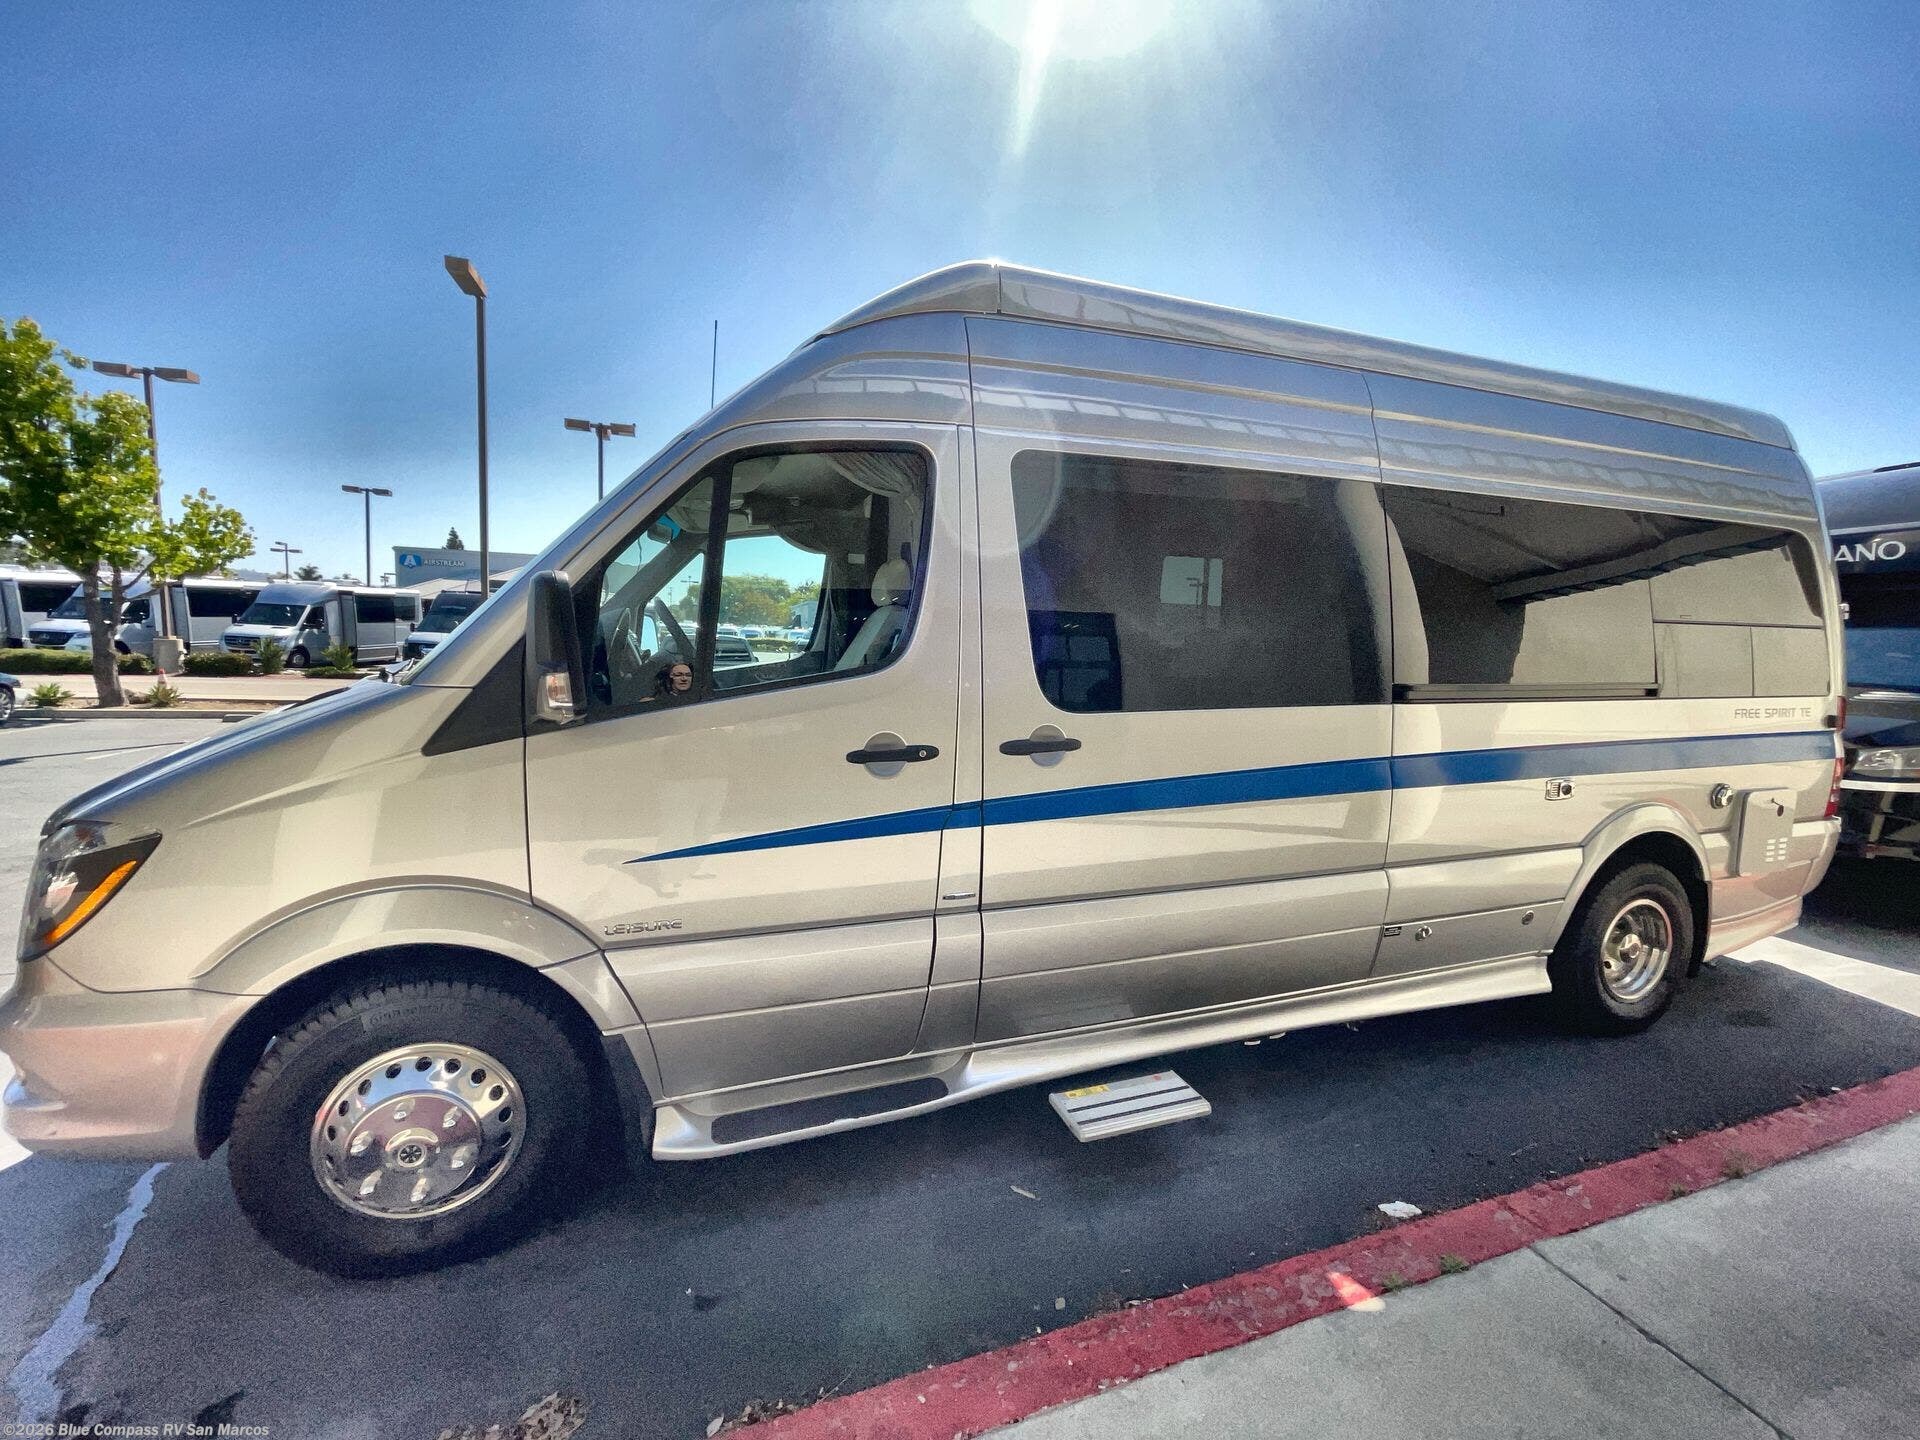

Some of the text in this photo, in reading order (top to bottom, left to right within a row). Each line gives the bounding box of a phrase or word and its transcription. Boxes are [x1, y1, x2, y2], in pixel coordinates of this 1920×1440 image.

[1834, 540, 1906, 562] ANO
[423, 559, 465, 568] AIRSTREAM
[1734, 707, 1811, 719] FREE SPIRIT TE
[604, 918, 682, 936] LEISURE
